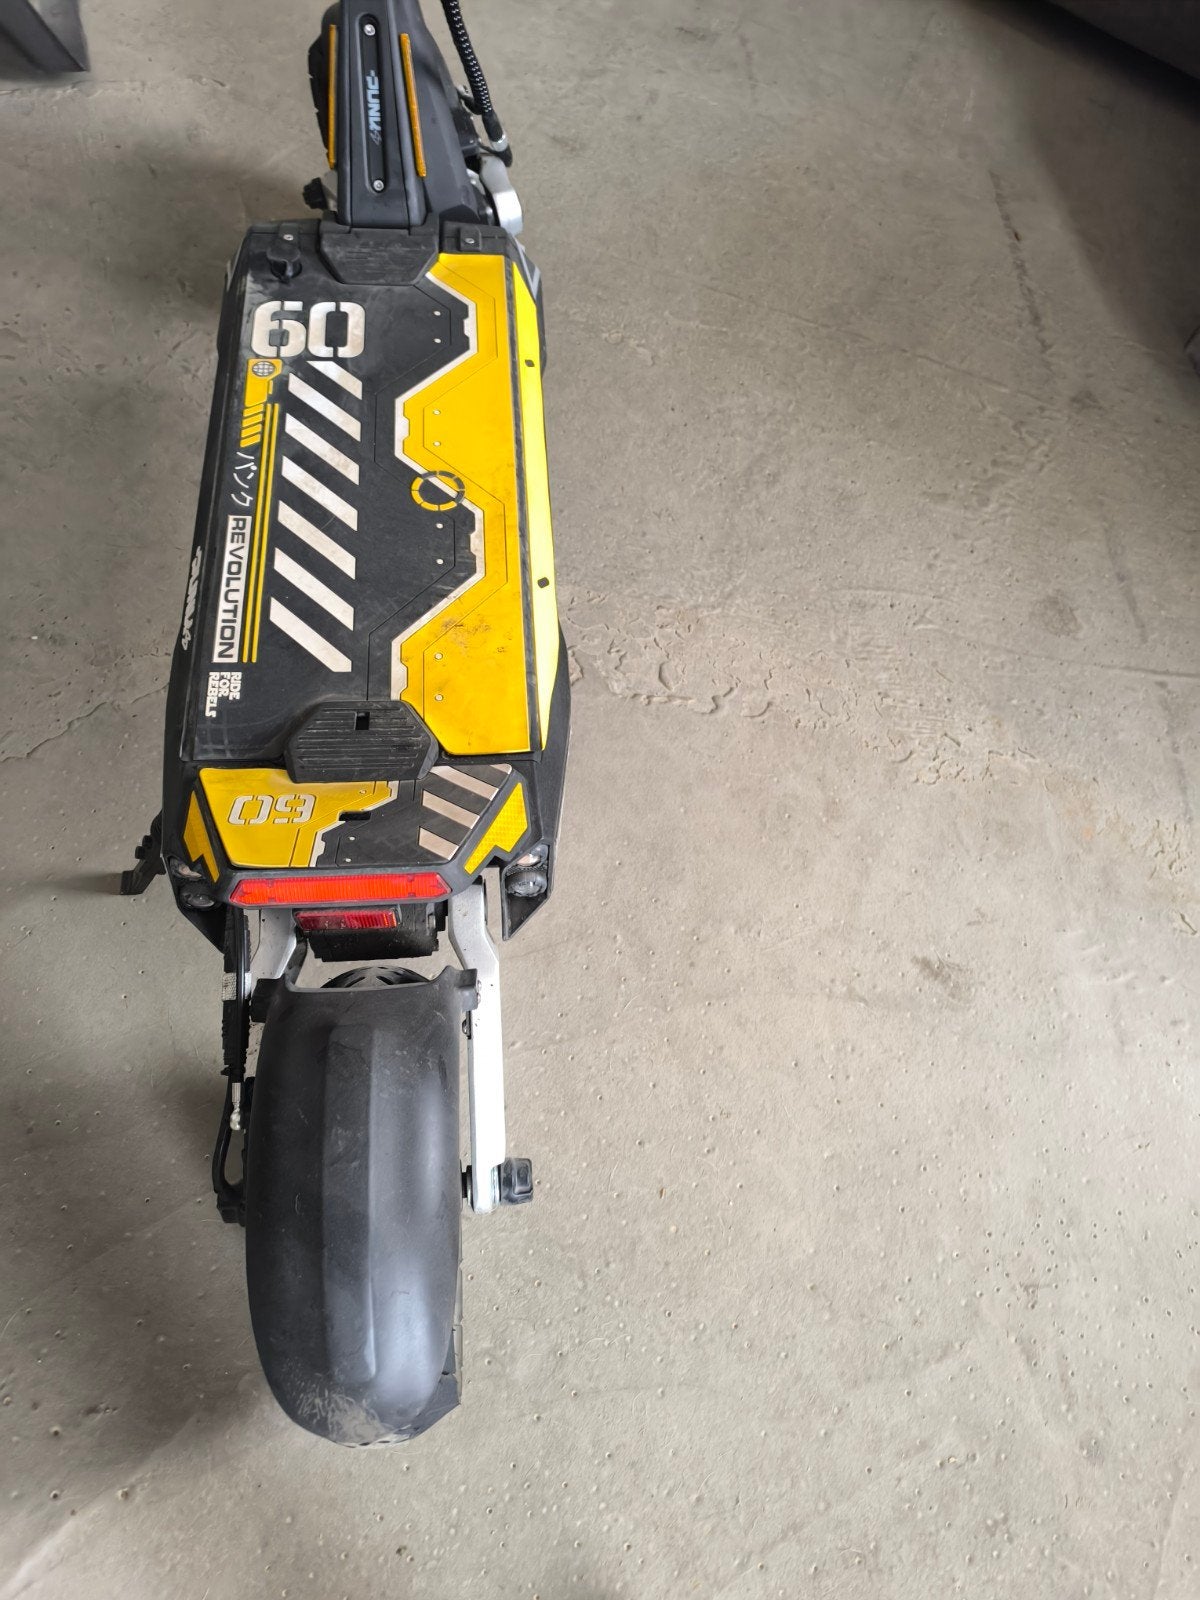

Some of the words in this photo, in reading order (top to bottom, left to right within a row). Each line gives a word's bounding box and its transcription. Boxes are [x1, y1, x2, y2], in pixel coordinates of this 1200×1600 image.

[250, 300, 365, 358] 60
[216, 517, 247, 660] REVOLUTION
[205, 672, 219, 718] REBELS
[218, 672, 231, 697] FOR
[229, 672, 242, 700] RIDE
